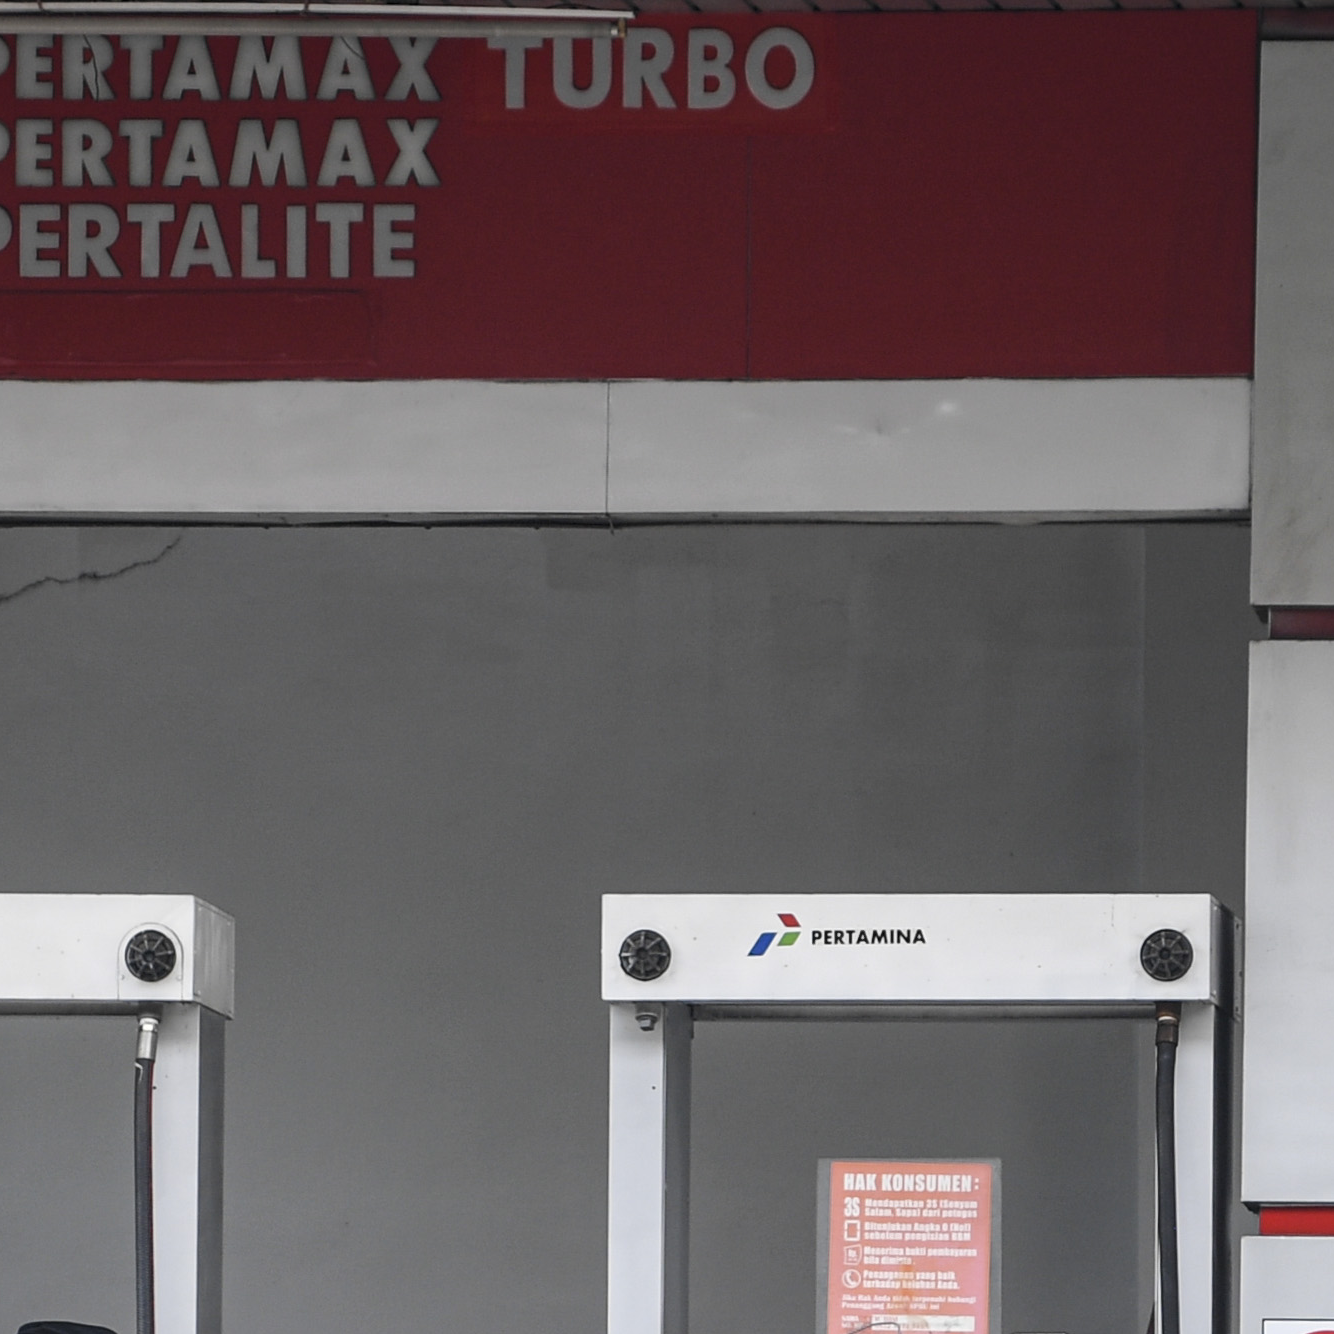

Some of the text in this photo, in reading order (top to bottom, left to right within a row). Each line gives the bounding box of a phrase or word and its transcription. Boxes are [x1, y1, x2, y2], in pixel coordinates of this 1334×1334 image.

[486, 26, 816, 110] TURBO
[811, 929, 926, 945] PERTAMINA
[843, 1173, 877, 1191] HAK
[844, 1197, 860, 1217] 3S
